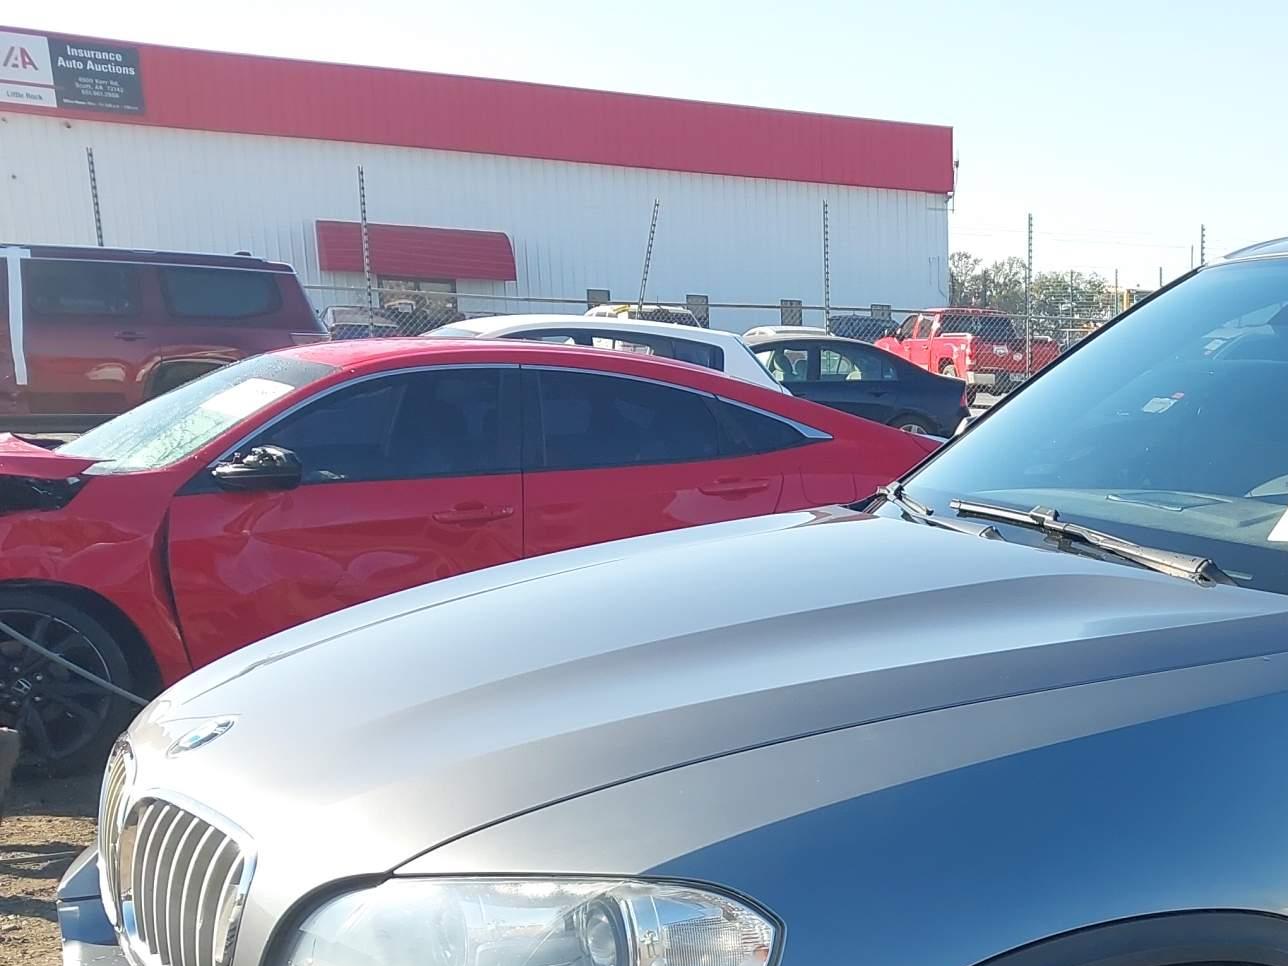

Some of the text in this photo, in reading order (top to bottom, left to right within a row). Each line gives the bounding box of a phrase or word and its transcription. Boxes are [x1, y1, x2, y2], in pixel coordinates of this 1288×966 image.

[66, 45, 122, 62] Insurance
[57, 57, 136, 76] Auto Auctions
